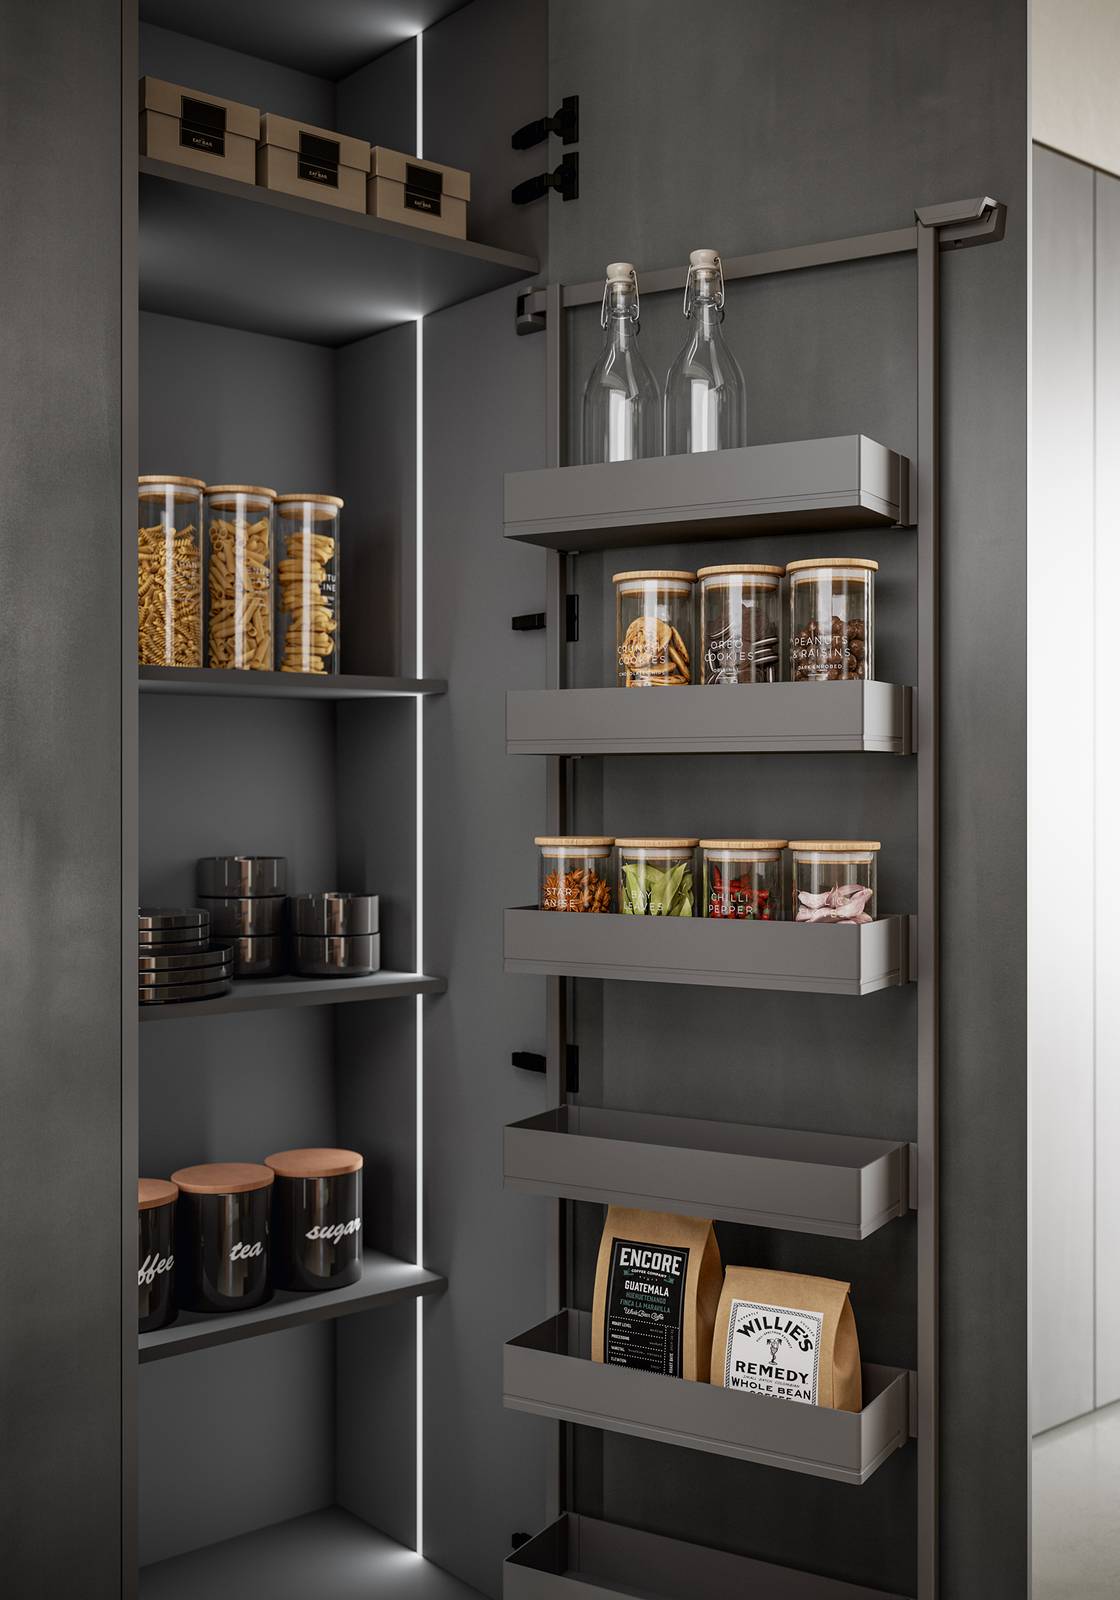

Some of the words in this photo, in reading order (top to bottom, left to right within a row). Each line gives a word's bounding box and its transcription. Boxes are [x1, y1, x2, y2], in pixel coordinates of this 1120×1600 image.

[710, 639, 743, 650] OREO
[794, 635, 848, 646] PEANUTS
[704, 651, 754, 662] COOKIES
[792, 650, 798, 659] &
[801, 648, 851, 658] RAISINS
[546, 887, 573, 897] STAR
[711, 892, 749, 903] CHILLI
[623, 901, 664, 912] LEAVES
[708, 904, 753, 915] PEPPER
[305, 1217, 362, 1245] sugar
[229, 1241, 264, 1261] tea
[619, 1247, 683, 1276] ENCORE
[138, 1252, 175, 1286] ffee
[624, 1280, 670, 1297] GUATEMALA
[736, 1316, 813, 1352] WILLIE'S
[735, 1360, 809, 1384] REMEDY
[731, 1376, 773, 1392] WHOLE
[777, 1387, 811, 1401] BEAN
